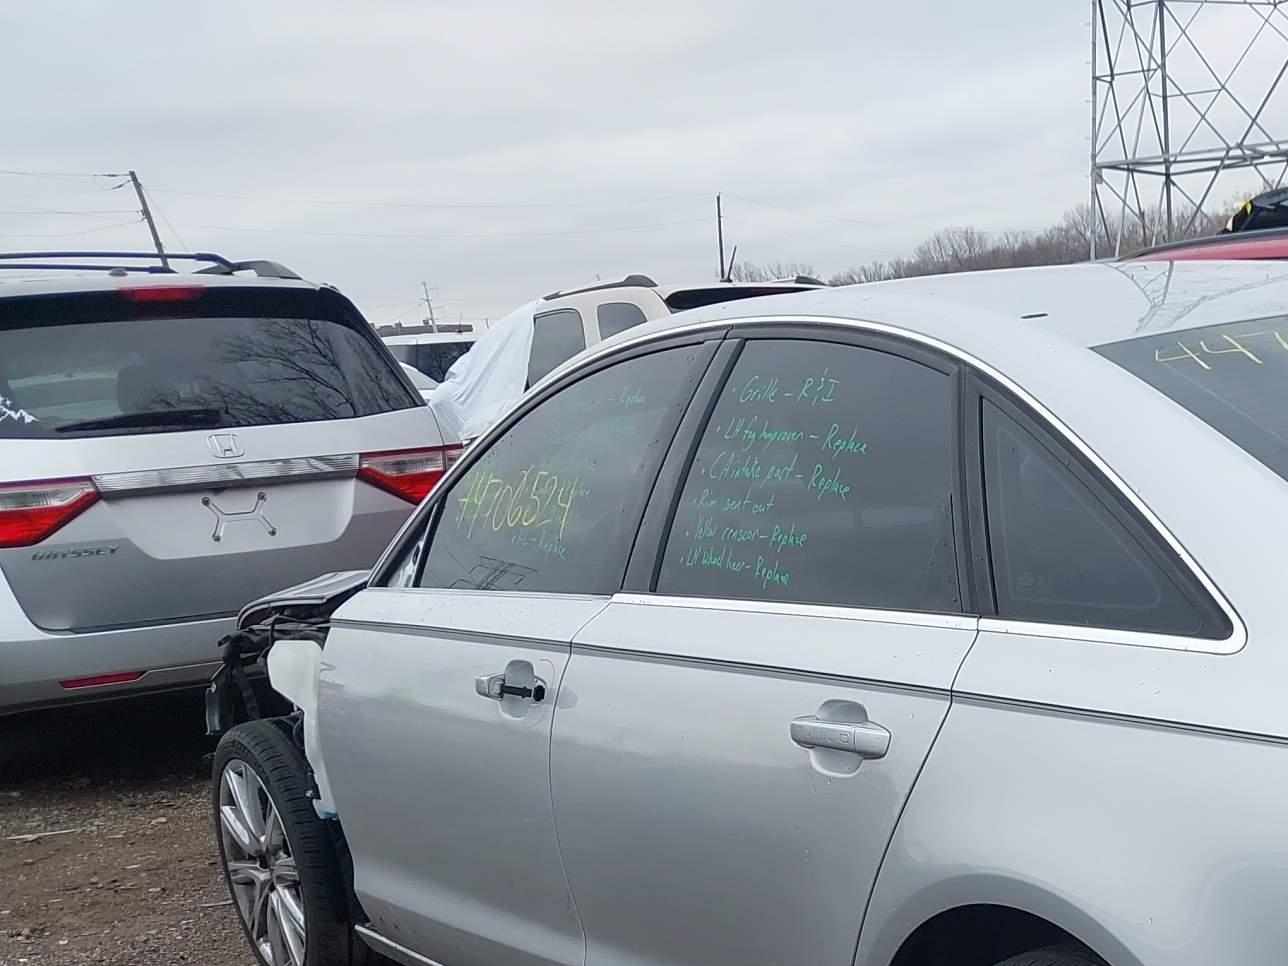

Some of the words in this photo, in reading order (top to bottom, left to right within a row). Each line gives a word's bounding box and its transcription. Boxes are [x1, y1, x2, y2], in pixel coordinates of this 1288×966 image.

[740, 376, 778, 403] Grille
[822, 423, 867, 460] Replace
[808, 464, 850, 500] Replace
[769, 523, 807, 552] Replace
